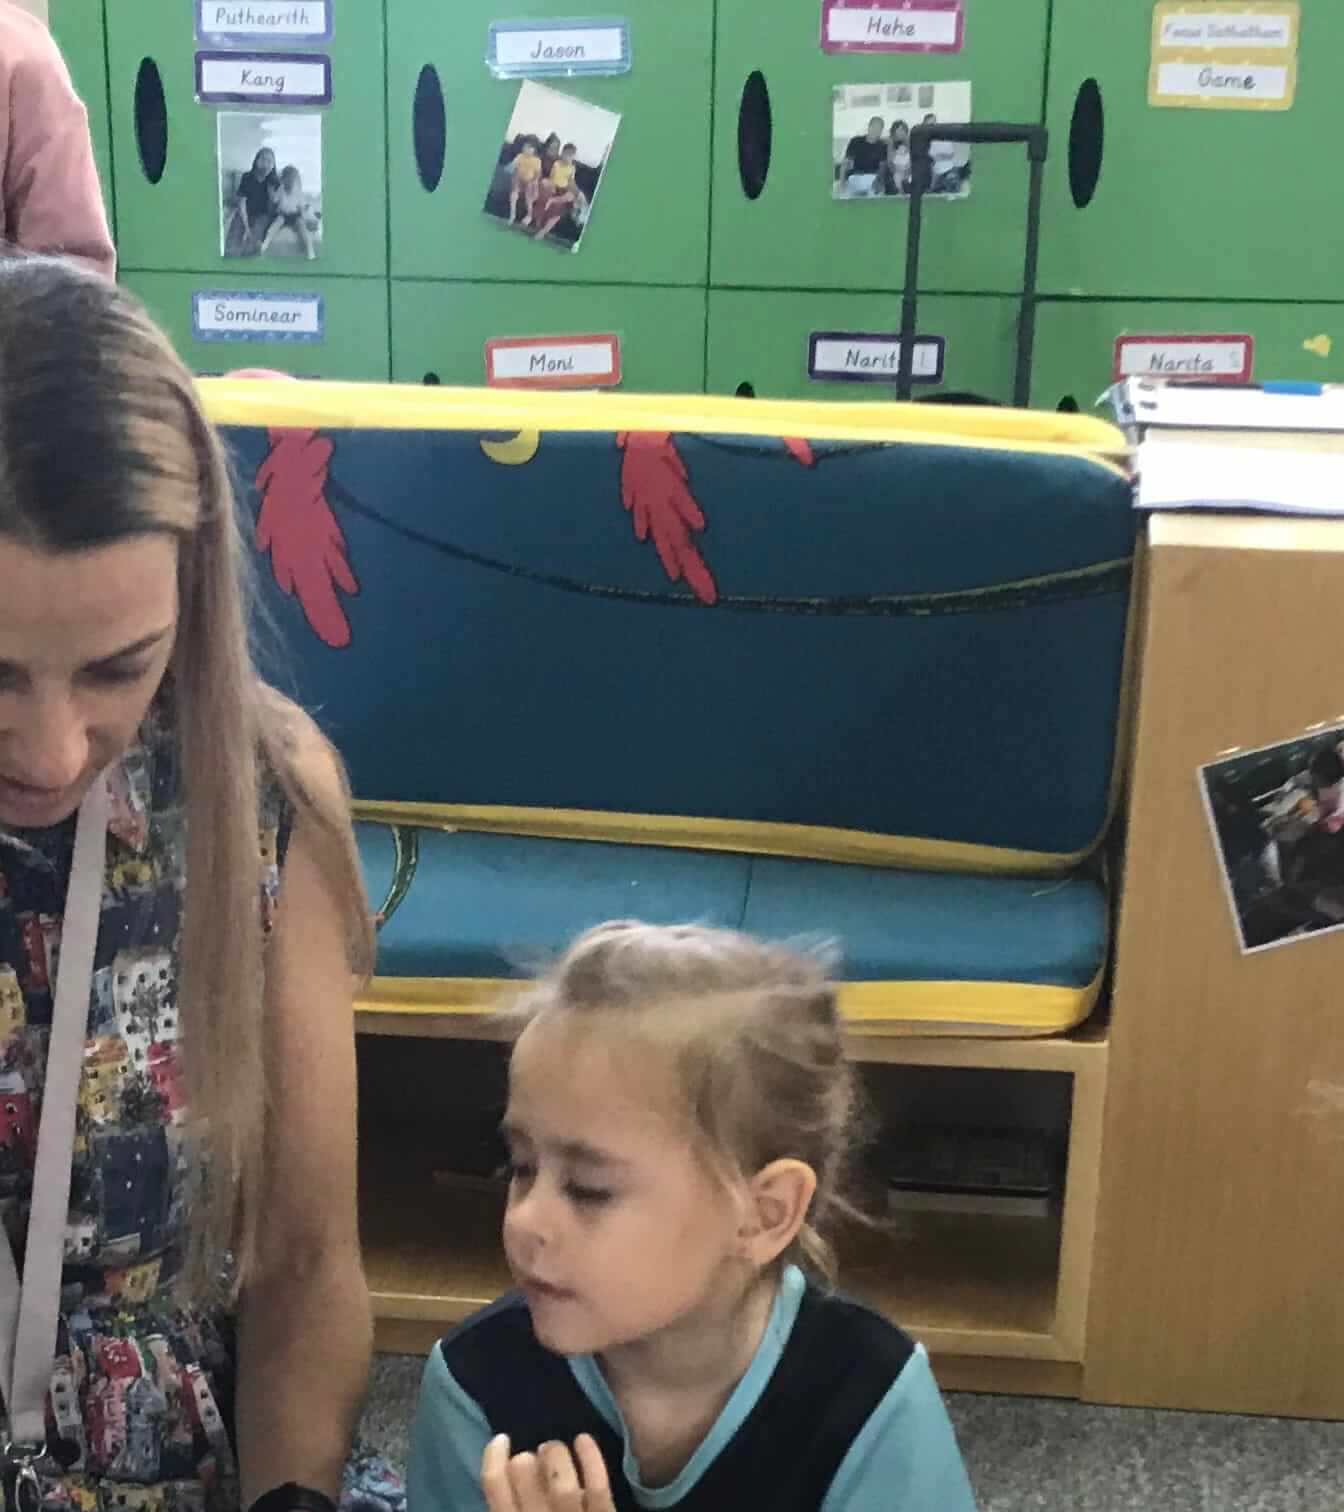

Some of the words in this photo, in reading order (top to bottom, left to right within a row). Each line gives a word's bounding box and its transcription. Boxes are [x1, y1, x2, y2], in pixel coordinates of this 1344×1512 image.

[866, 16, 916, 37] Hehe
[530, 40, 585, 59] Jason
[241, 69, 286, 93] Kang
[529, 353, 575, 373] Moni
[845, 349, 899, 369] Narit
[1149, 350, 1215, 372] Narita
